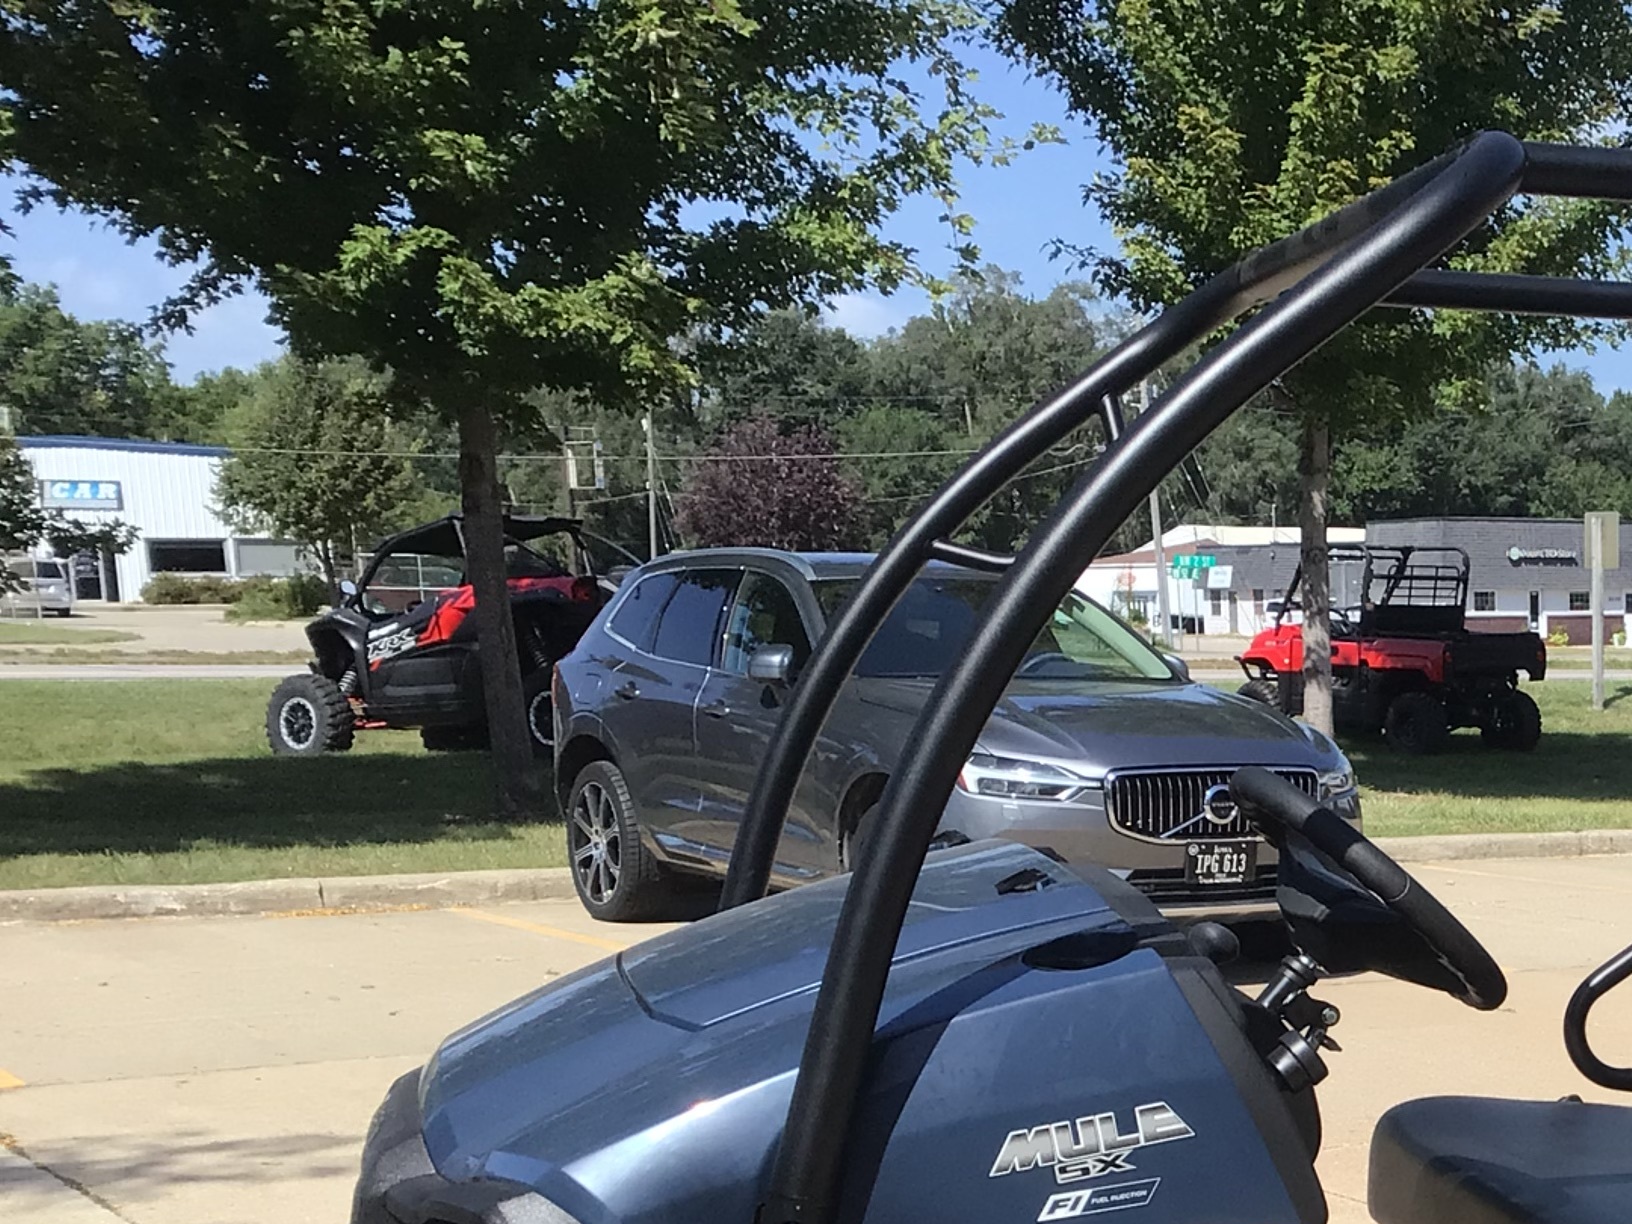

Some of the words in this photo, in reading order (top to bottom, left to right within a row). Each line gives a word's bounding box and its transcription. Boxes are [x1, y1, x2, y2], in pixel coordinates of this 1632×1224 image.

[51, 482, 118, 499] CAR
[1195, 853, 1220, 874] IPG
[1223, 852, 1247, 873] 613
[988, 1100, 1196, 1178] MULE
[1054, 1150, 1138, 1185] SX
